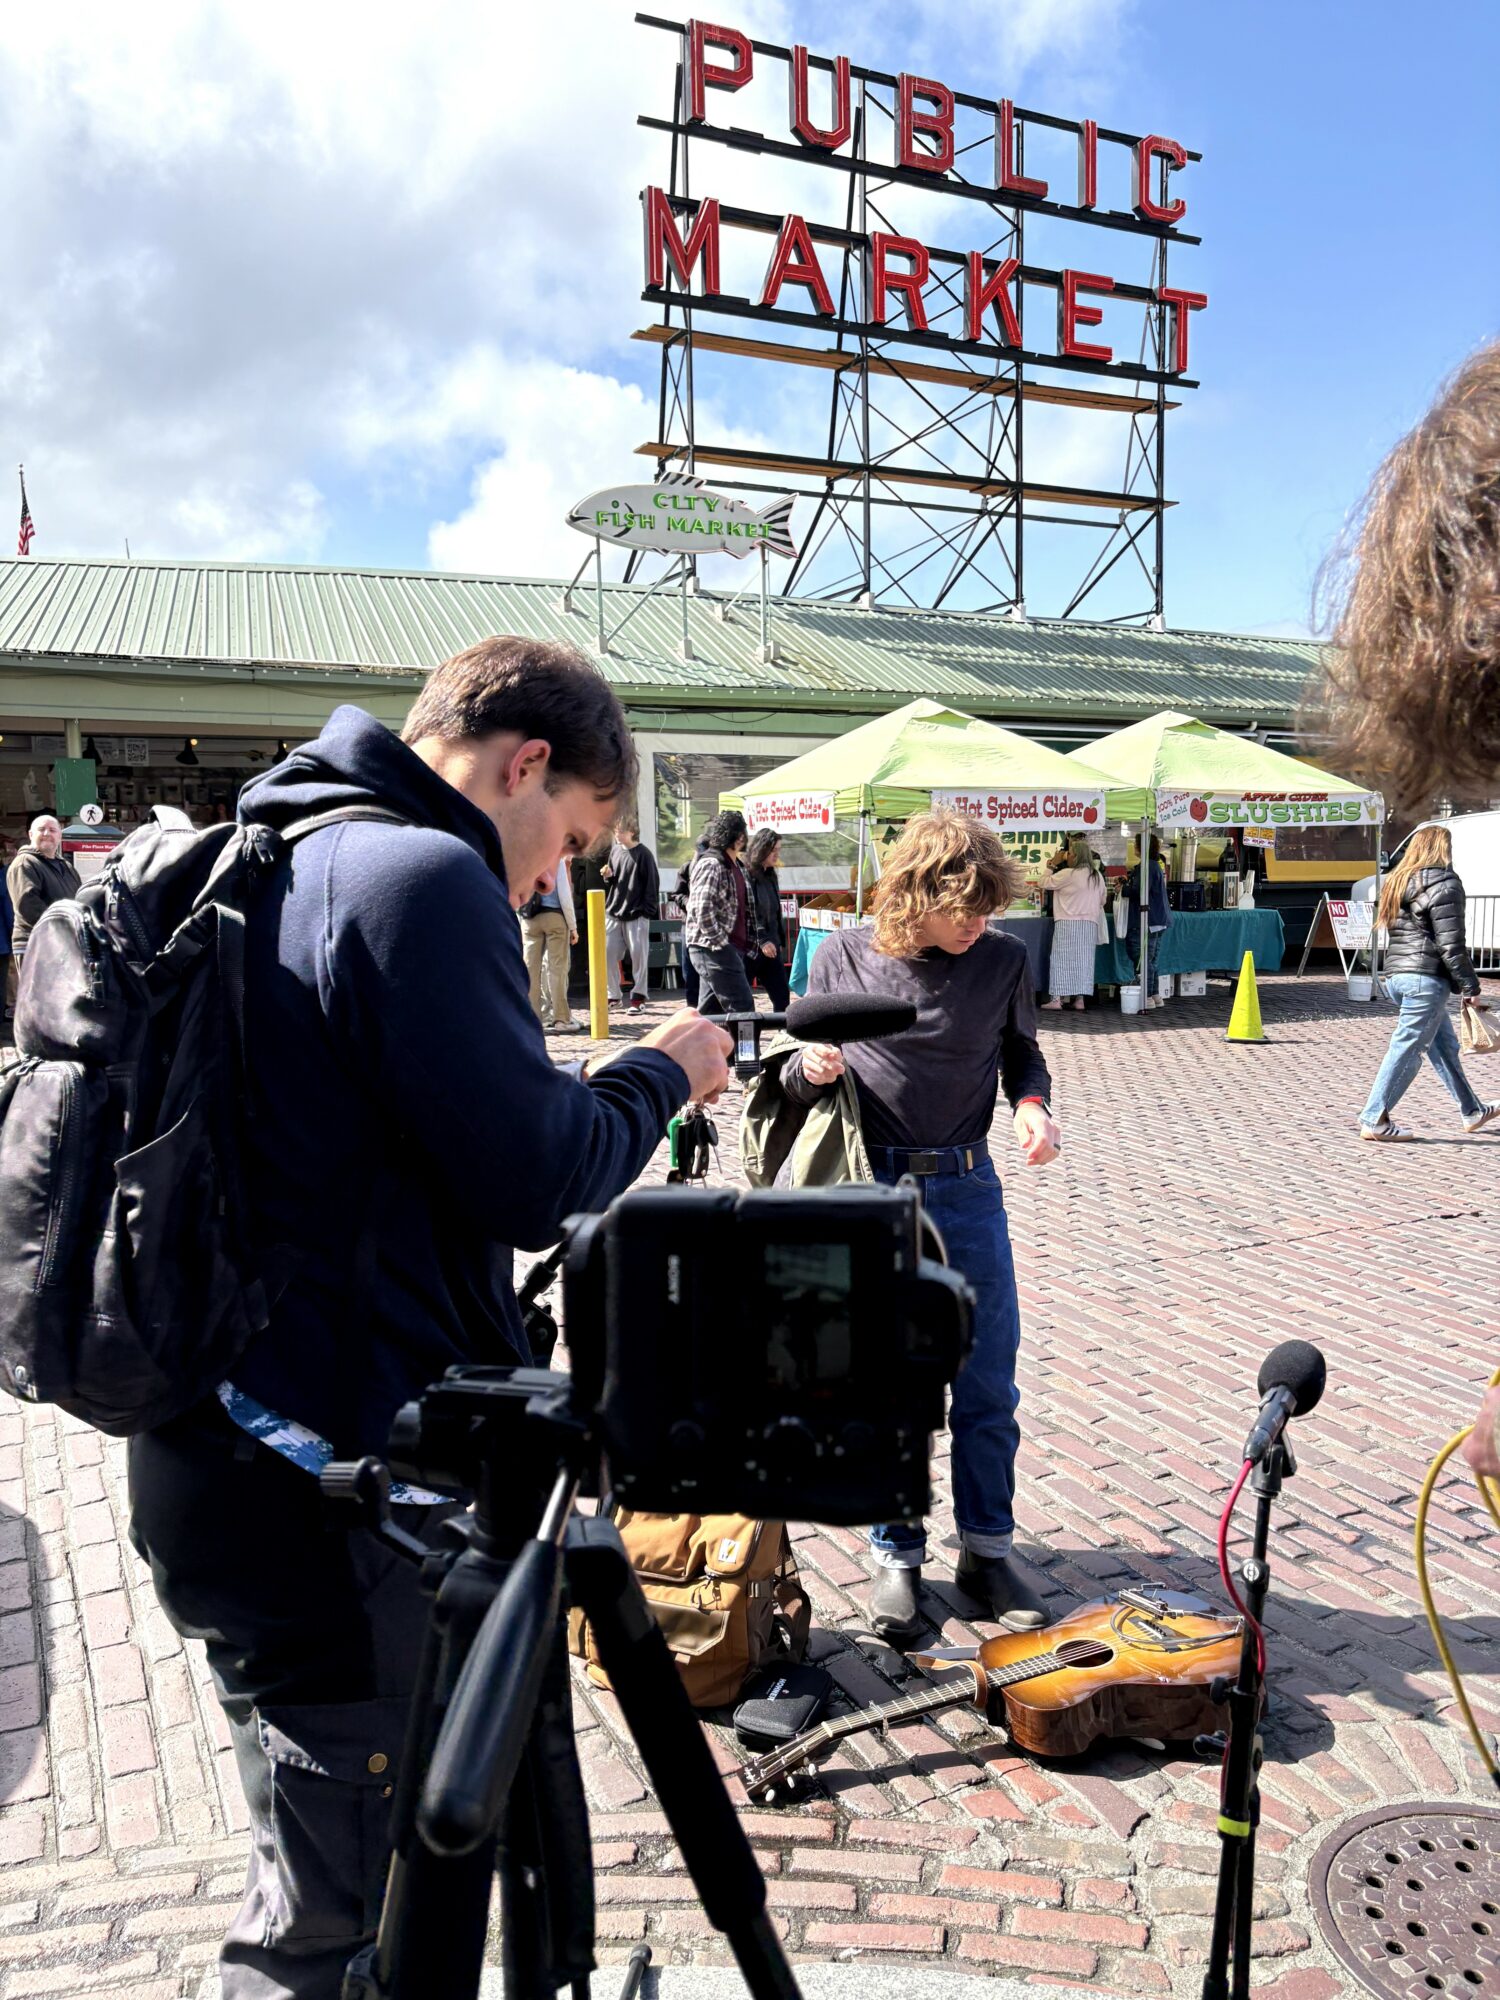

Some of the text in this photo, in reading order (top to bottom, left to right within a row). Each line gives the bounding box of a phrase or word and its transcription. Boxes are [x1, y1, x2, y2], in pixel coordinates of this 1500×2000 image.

[684, 19, 1187, 225] PUBLIC
[643, 186, 1207, 375] MARKET
[653, 493, 719, 512] CITY
[596, 511, 775, 538] FISH MARKET
[1158, 792, 1190, 812] 100% Pure
[1241, 792, 1328, 801] APPLE CIDER
[756, 797, 821, 828] Hot Spiced Cider
[956, 795, 1084, 825] Hot Spiced Cider
[1160, 804, 1188, 822] Ice Cold
[1209, 801, 1361, 823] SLUSHIES
[998, 831, 1067, 847] amily
[1330, 903, 1345, 915] NO
[667, 1254, 680, 1304] SONY
[767, 1678, 787, 1701] HOHNER
